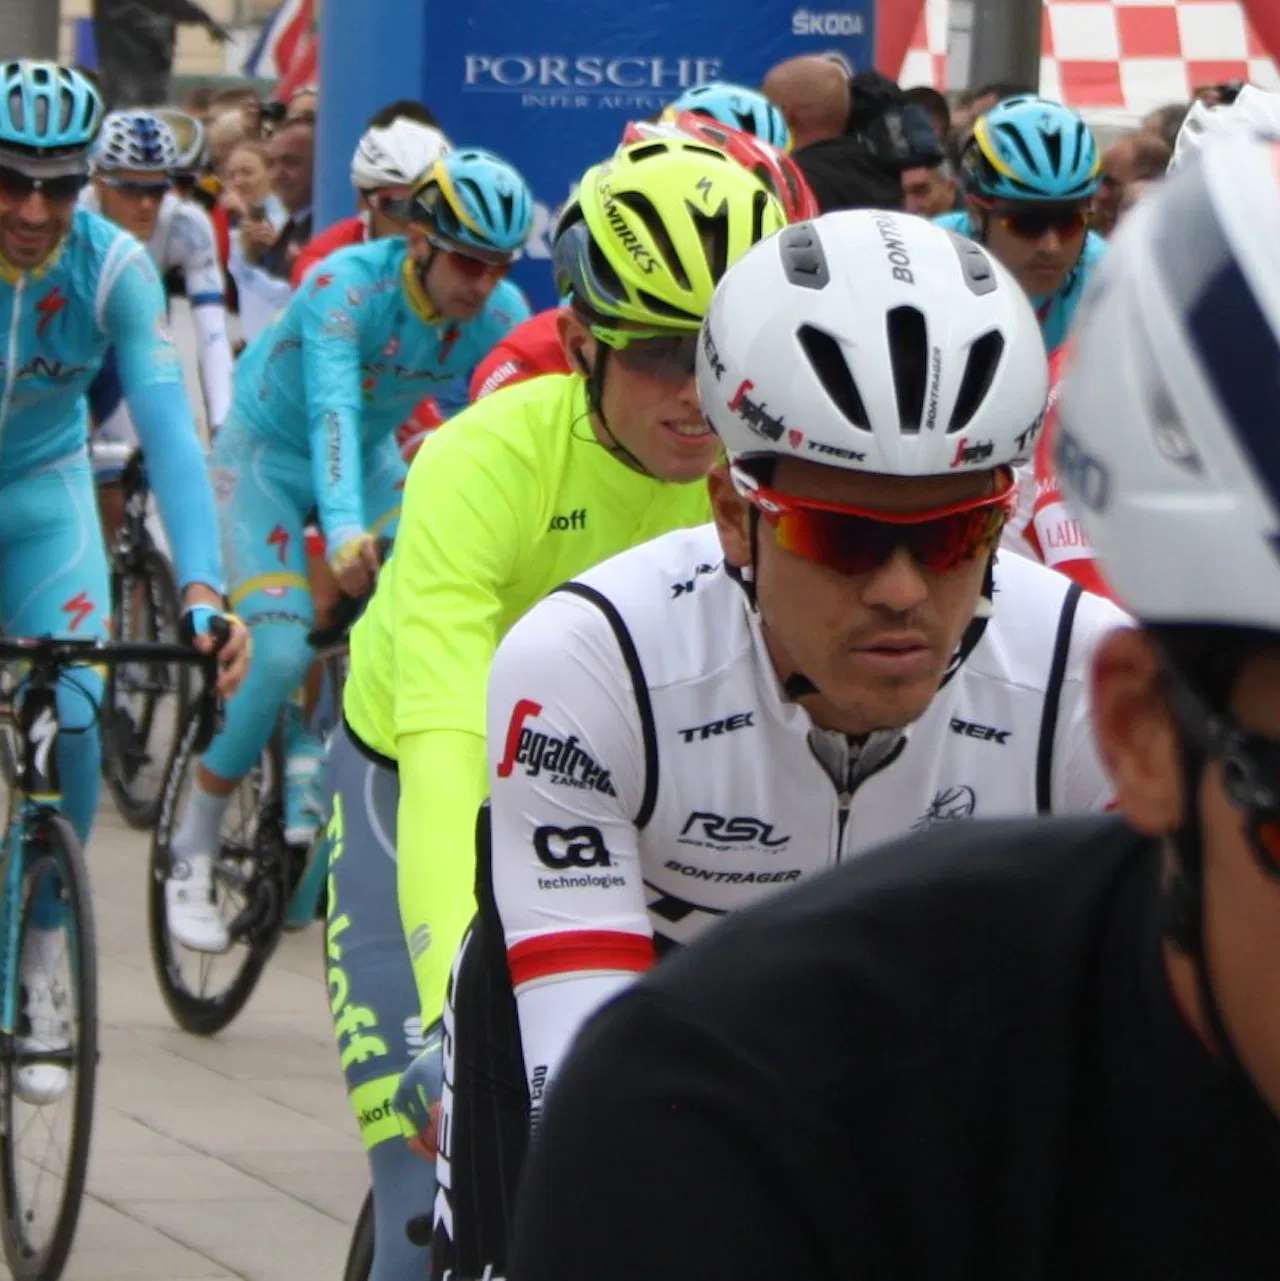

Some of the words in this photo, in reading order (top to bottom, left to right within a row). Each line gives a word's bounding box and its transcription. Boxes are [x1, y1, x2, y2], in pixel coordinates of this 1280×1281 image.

[791, 9, 864, 36] ŠKODA
[463, 54, 723, 89] PORSCHE
[521, 93, 589, 109] INTER
[598, 182, 661, 276] S-WORKS
[926, 346, 943, 432] BONTRAGER
[807, 441, 867, 462] TREK
[533, 825, 613, 870] ca
[537, 874, 627, 891] technologies
[663, 860, 802, 884] BONTRAGER
